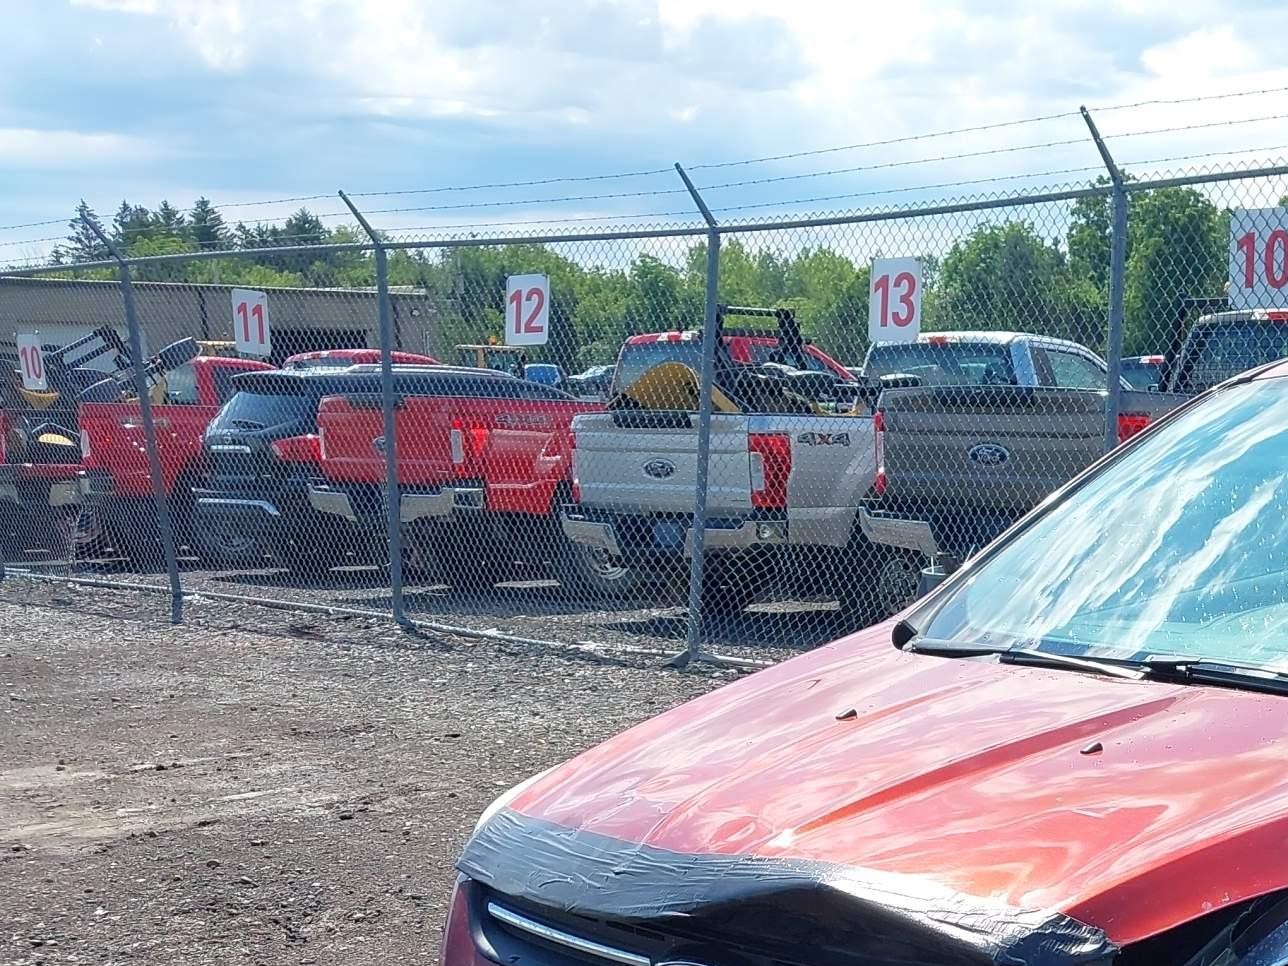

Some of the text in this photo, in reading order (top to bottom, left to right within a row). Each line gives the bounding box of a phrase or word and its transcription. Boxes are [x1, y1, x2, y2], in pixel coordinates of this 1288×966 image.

[509, 287, 545, 334] 12
[874, 271, 916, 327] 13
[237, 302, 265, 344] 11
[20, 345, 42, 379] 10
